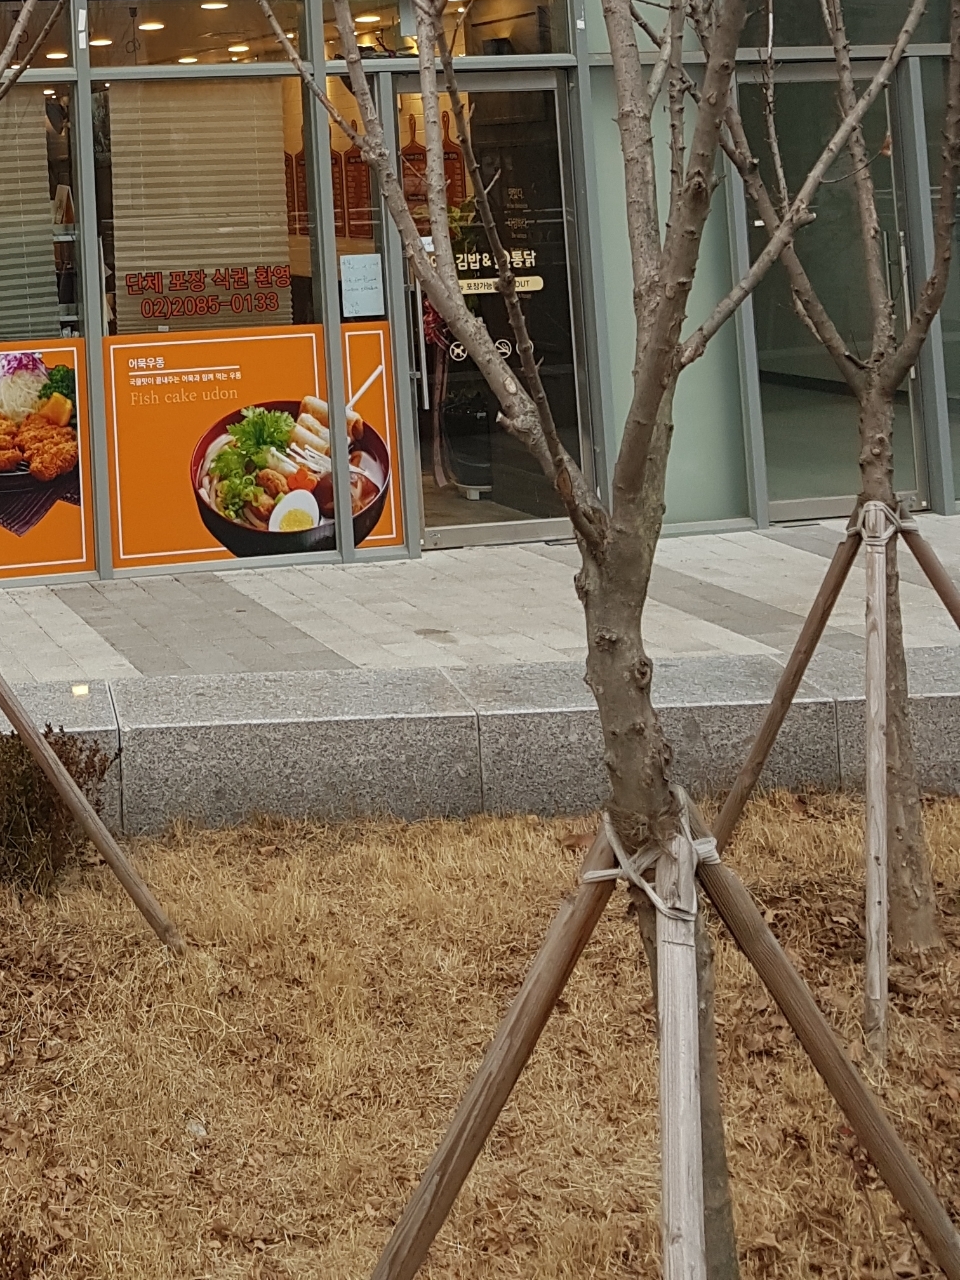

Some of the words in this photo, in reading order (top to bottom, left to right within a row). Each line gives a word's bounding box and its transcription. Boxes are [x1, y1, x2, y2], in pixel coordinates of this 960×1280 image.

[510, 249, 537, 268] 통닭
[125, 271, 164, 296] 단체
[168, 268, 207, 293] 포장
[211, 266, 250, 291] 식권
[254, 264, 292, 289] 환영
[140, 291, 280, 320] 02)2085-0133
[128, 357, 165, 370] 어묵우동
[130, 390, 160, 406] Fish
[164, 387, 197, 403] cake
[202, 386, 238, 401] udon
